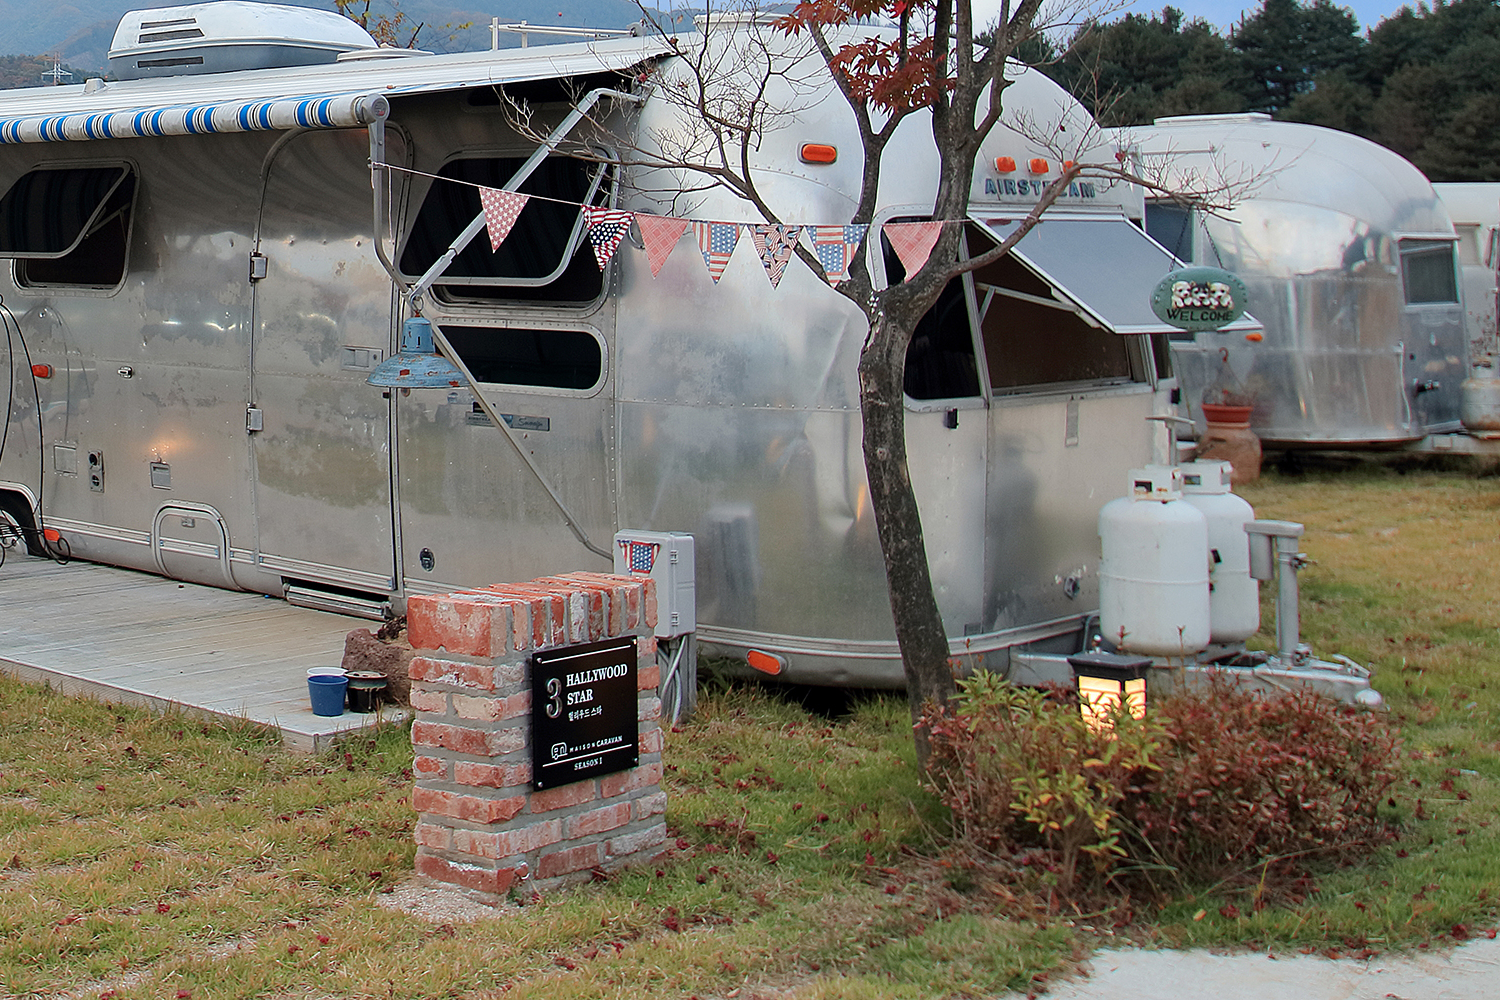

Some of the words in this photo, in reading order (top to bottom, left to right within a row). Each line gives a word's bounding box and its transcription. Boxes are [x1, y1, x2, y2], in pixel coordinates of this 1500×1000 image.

[985, 177, 1096, 198] AIRSTAM
[1166, 308, 1234, 321] WELCOME
[566, 663, 628, 687] HALLYWOOD
[546, 677, 563, 719] 3
[567, 689, 594, 706] STAR
[569, 742, 596, 753] MAISON
[596, 735, 623, 748] CARAVAN
[574, 758, 599, 771] SEASON
